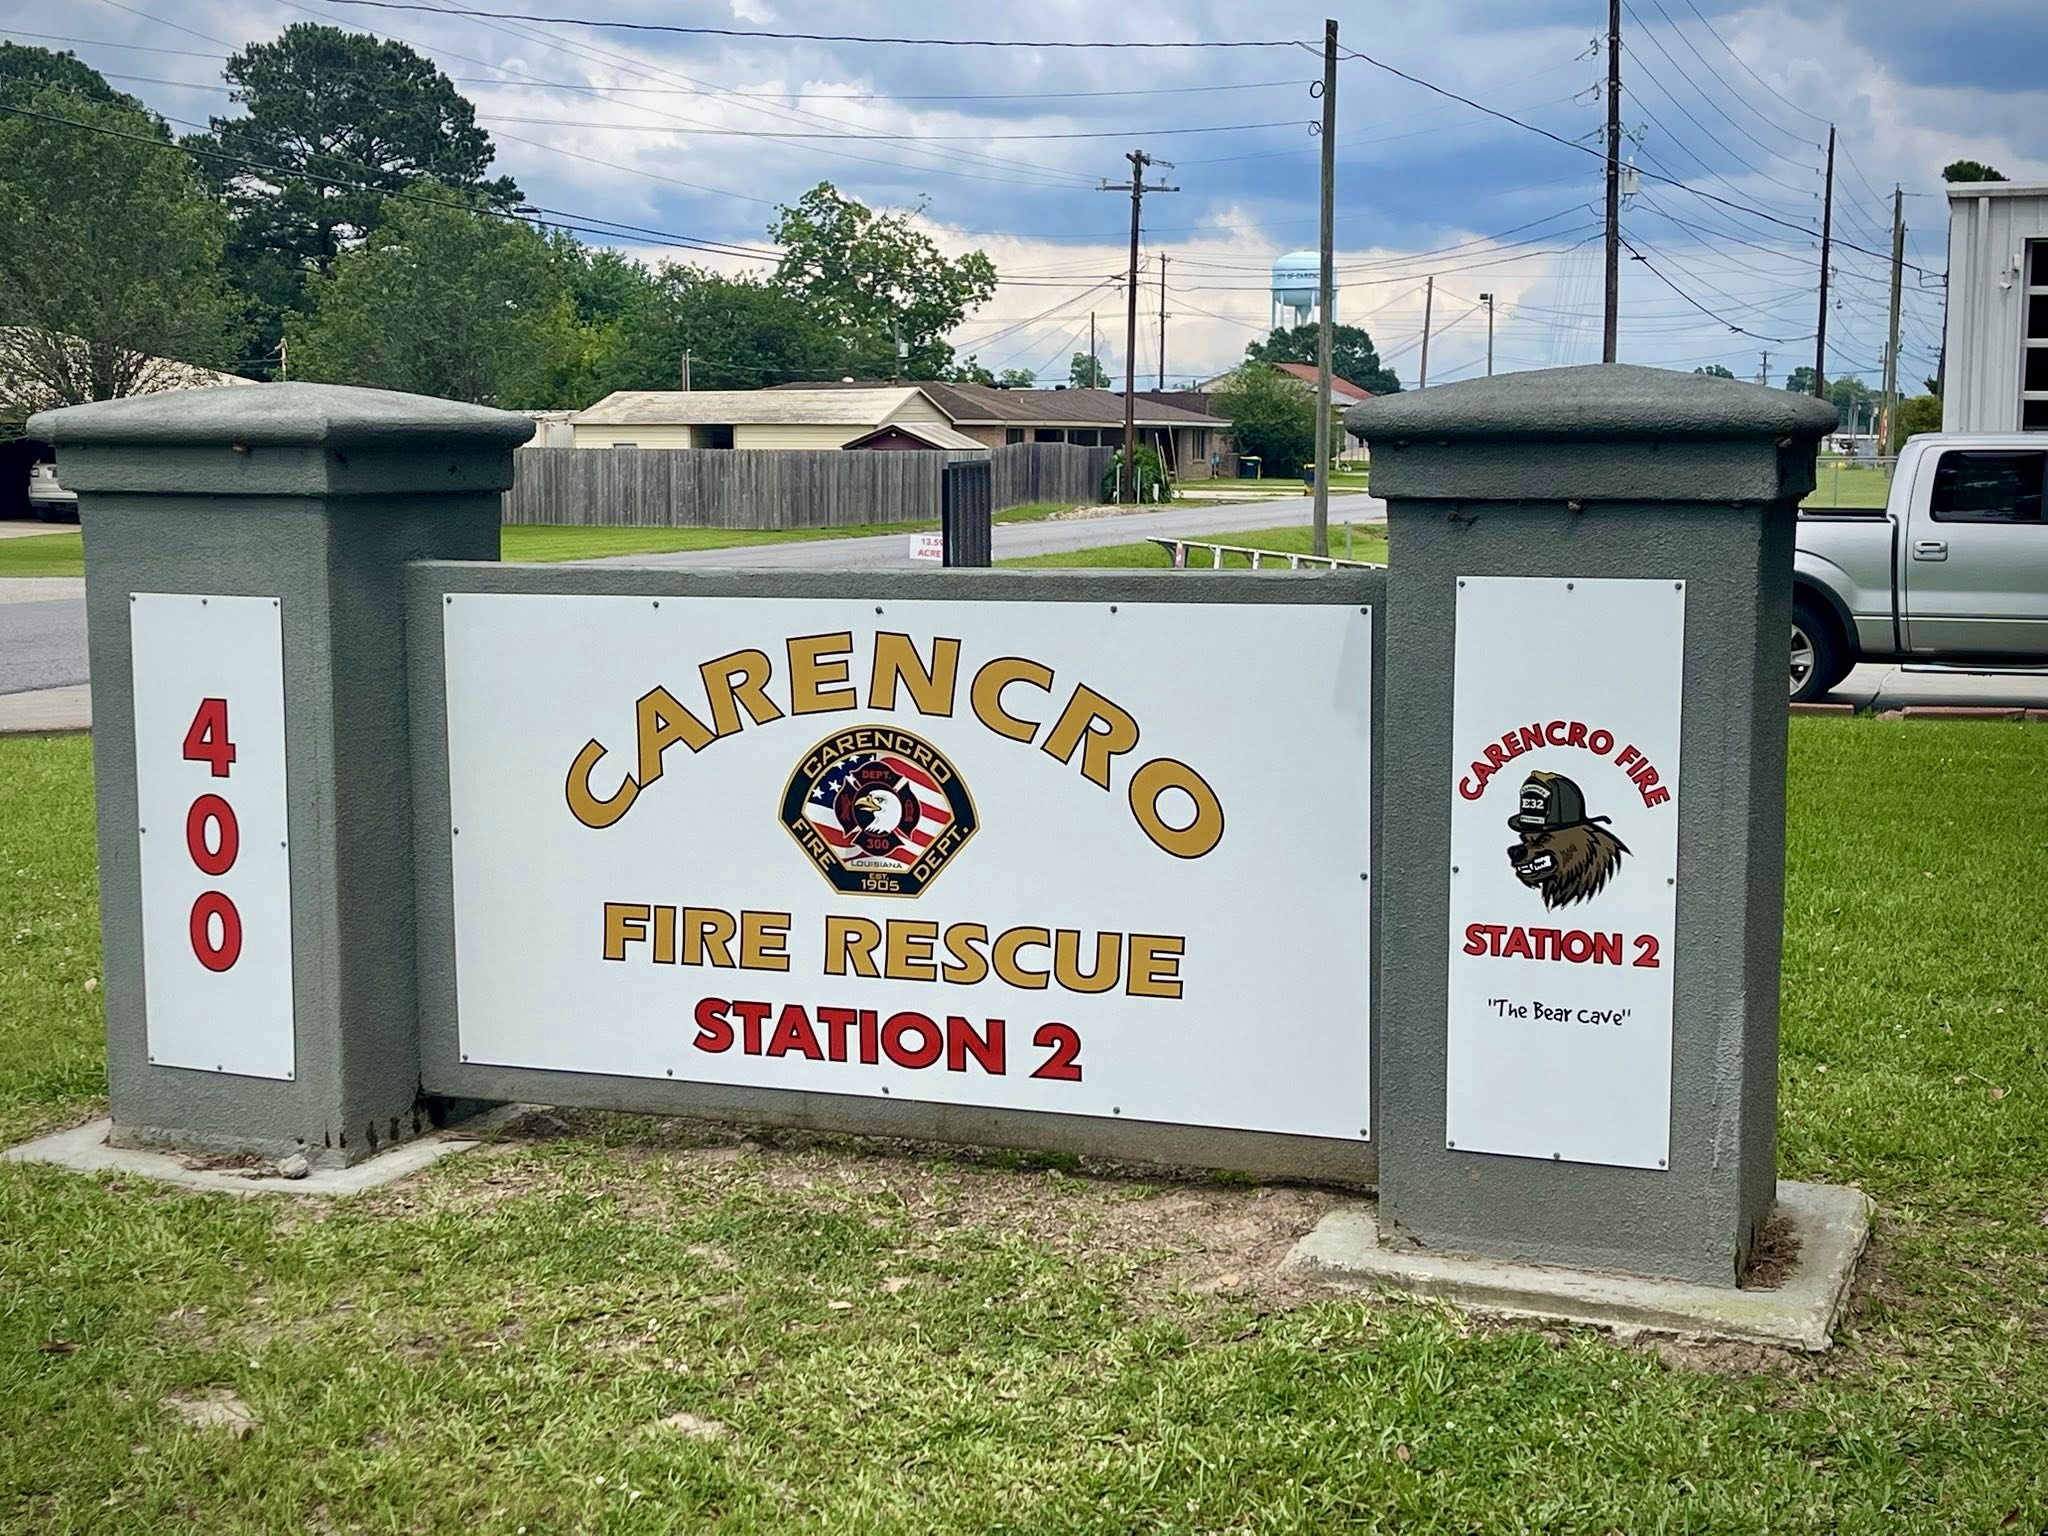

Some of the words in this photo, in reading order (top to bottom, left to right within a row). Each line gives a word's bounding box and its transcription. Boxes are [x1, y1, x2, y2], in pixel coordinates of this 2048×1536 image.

[566, 631, 1224, 859] CARENCRO
[803, 730, 952, 784] CARENCRO
[1459, 720, 1614, 801] CARENCRO
[1614, 744, 1671, 808] FIRE
[862, 769, 892, 780] DEPT.
[1521, 798, 1545, 810] E32
[184, 698, 241, 972] 400
[792, 817, 837, 872] FIRE
[913, 825, 969, 883] DEPT.
[866, 838, 890, 850] 300
[850, 860, 903, 869] LOUISIANA
[860, 878, 900, 891] 1905
[603, 902, 791, 972] FIRE
[824, 915, 1185, 999] RESCUE
[1463, 923, 1622, 966] STATION
[1632, 934, 1660, 969] 2
[1488, 998, 1528, 1019] "The
[1533, 1001, 1573, 1023] Bear
[693, 998, 1006, 1075] STATION
[1029, 1023, 1082, 1082] 2
